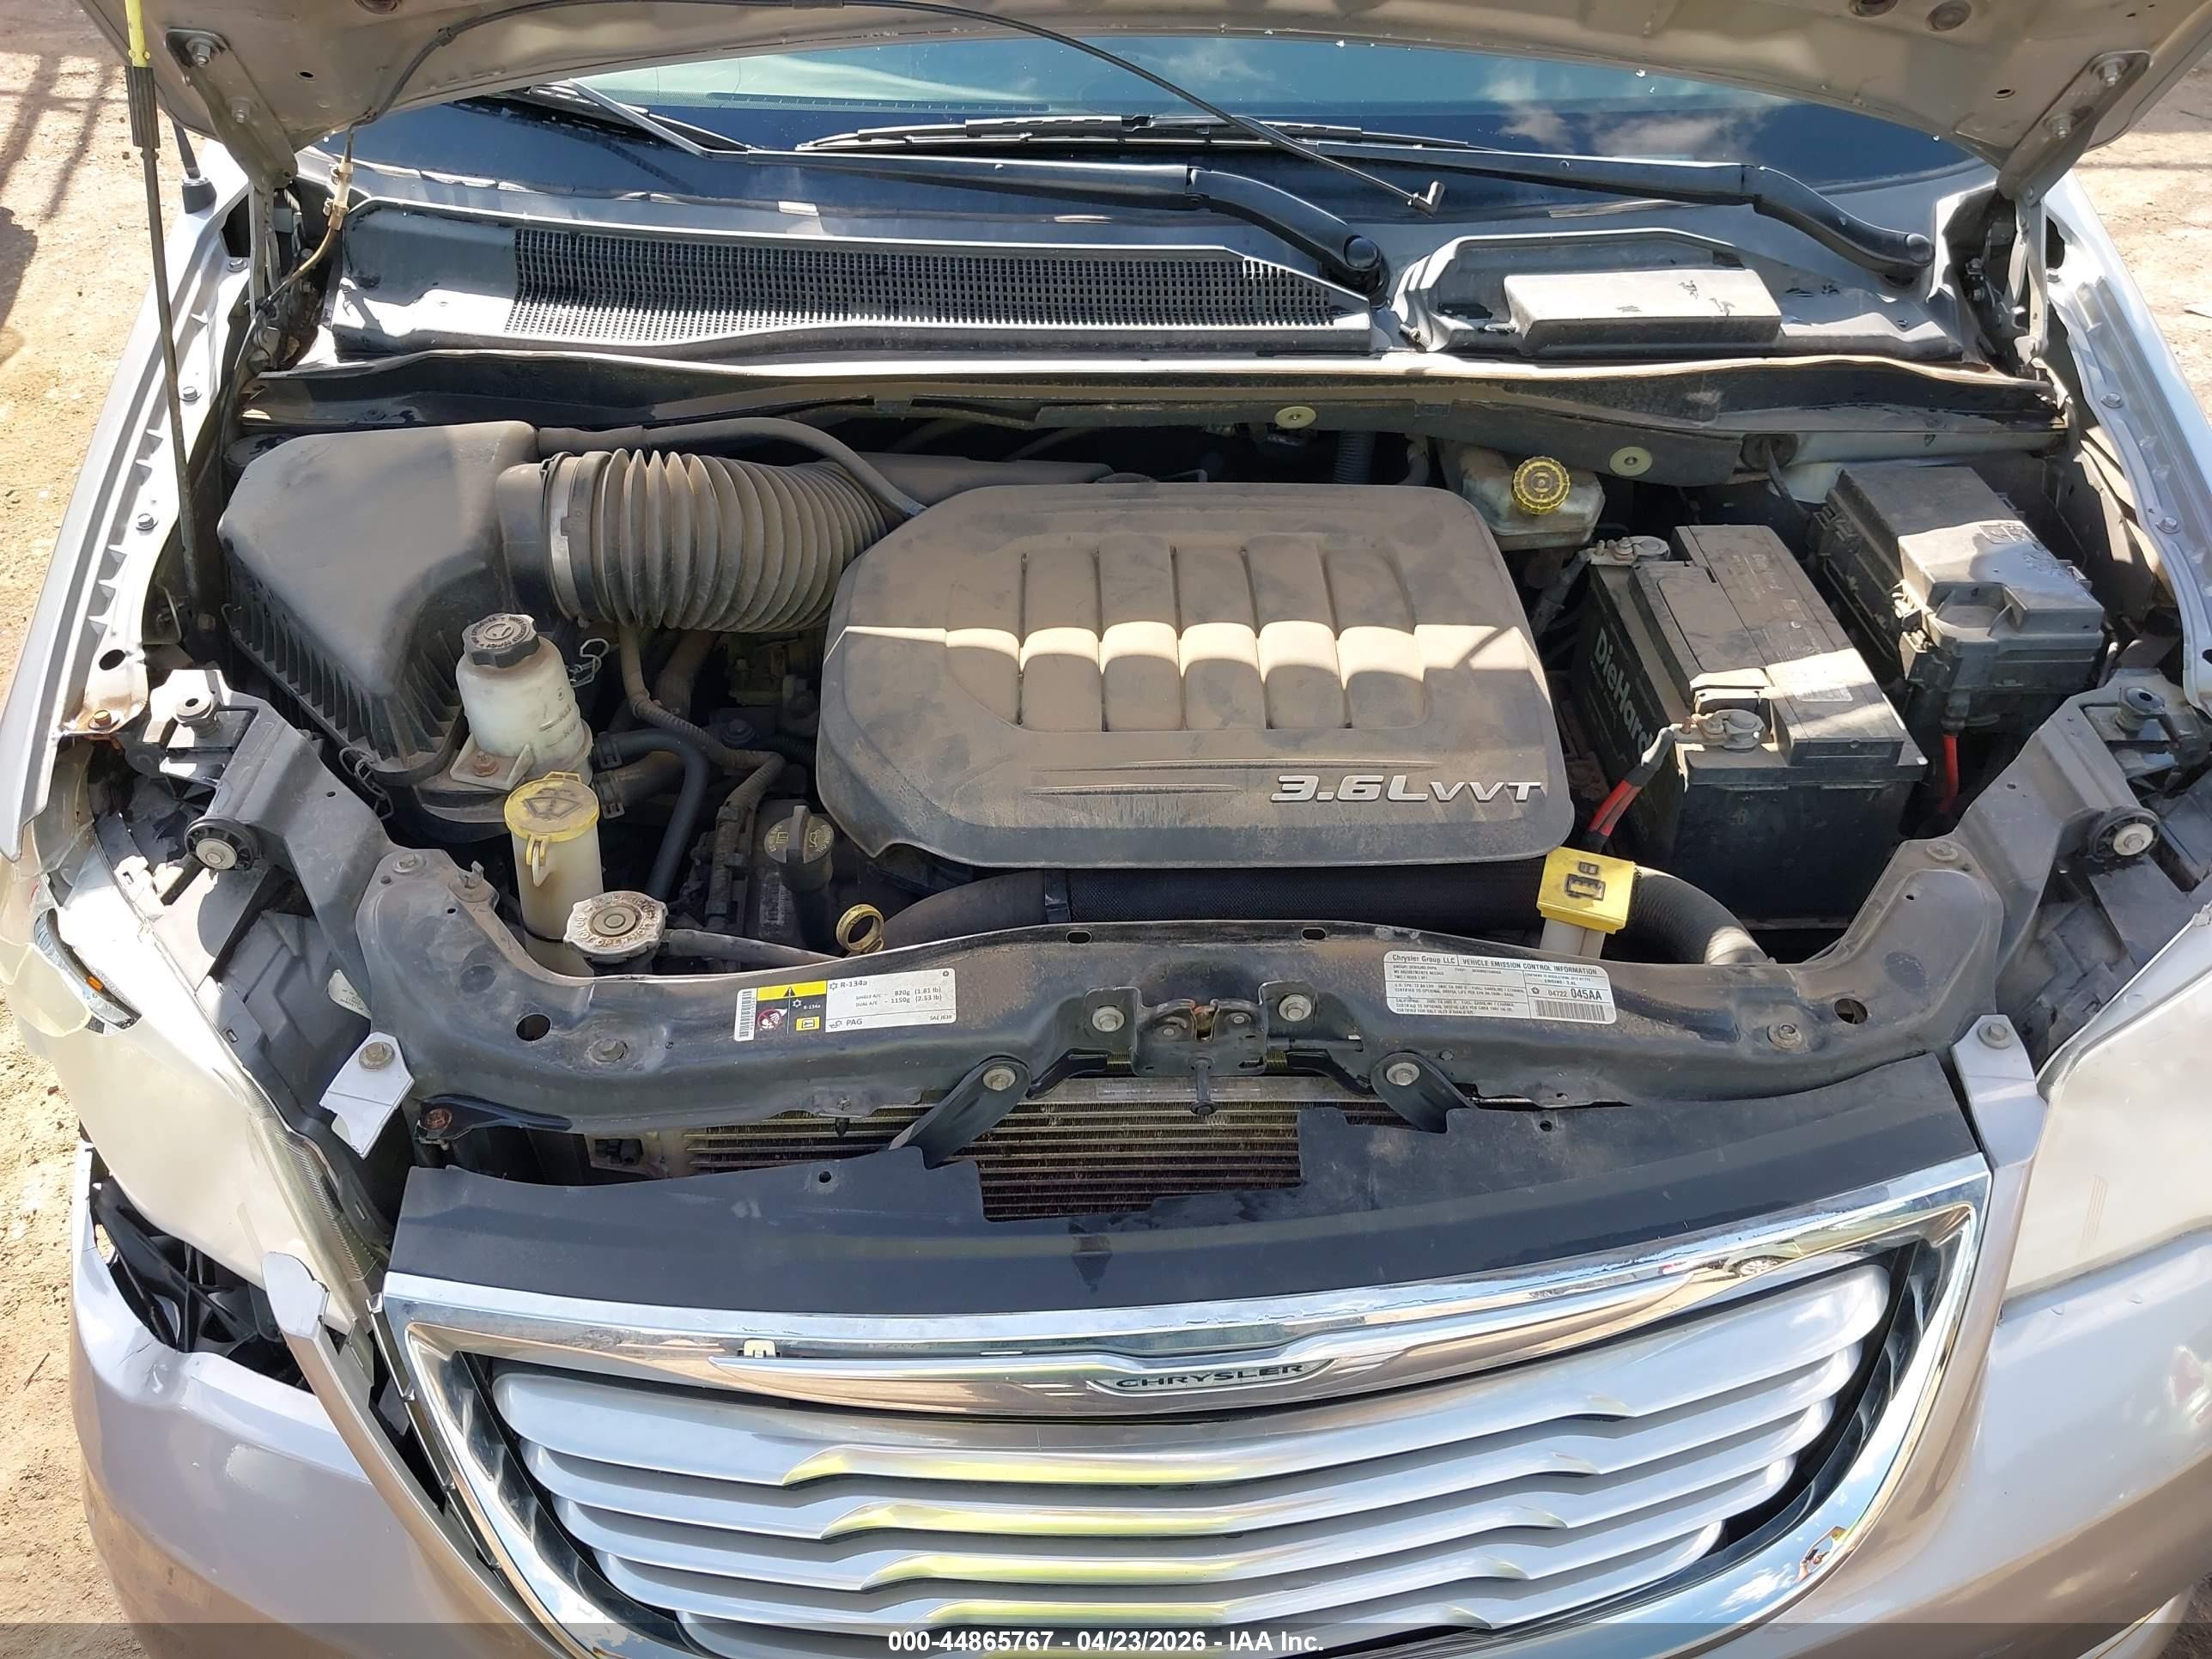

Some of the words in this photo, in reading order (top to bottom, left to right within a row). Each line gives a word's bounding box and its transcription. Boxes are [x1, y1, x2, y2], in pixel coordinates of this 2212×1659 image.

[1392, 954, 1419, 963] Chrysler
[1421, 955, 1441, 964] Group
[1462, 958, 1491, 967] VEHICLE
[1491, 960, 1521, 969] EMISSION
[1522, 963, 1552, 972] CONTROL
[1553, 966, 1597, 975] INFORMATION
[840, 979, 868, 988] R-134a
[890, 996, 911, 1005] 1150g
[933, 994, 942, 1002] lb)
[1547, 989, 1568, 998] 04722
[1570, 988, 1603, 1000] 045AA
[1116, 1364, 1304, 1388] CHRYSLER
